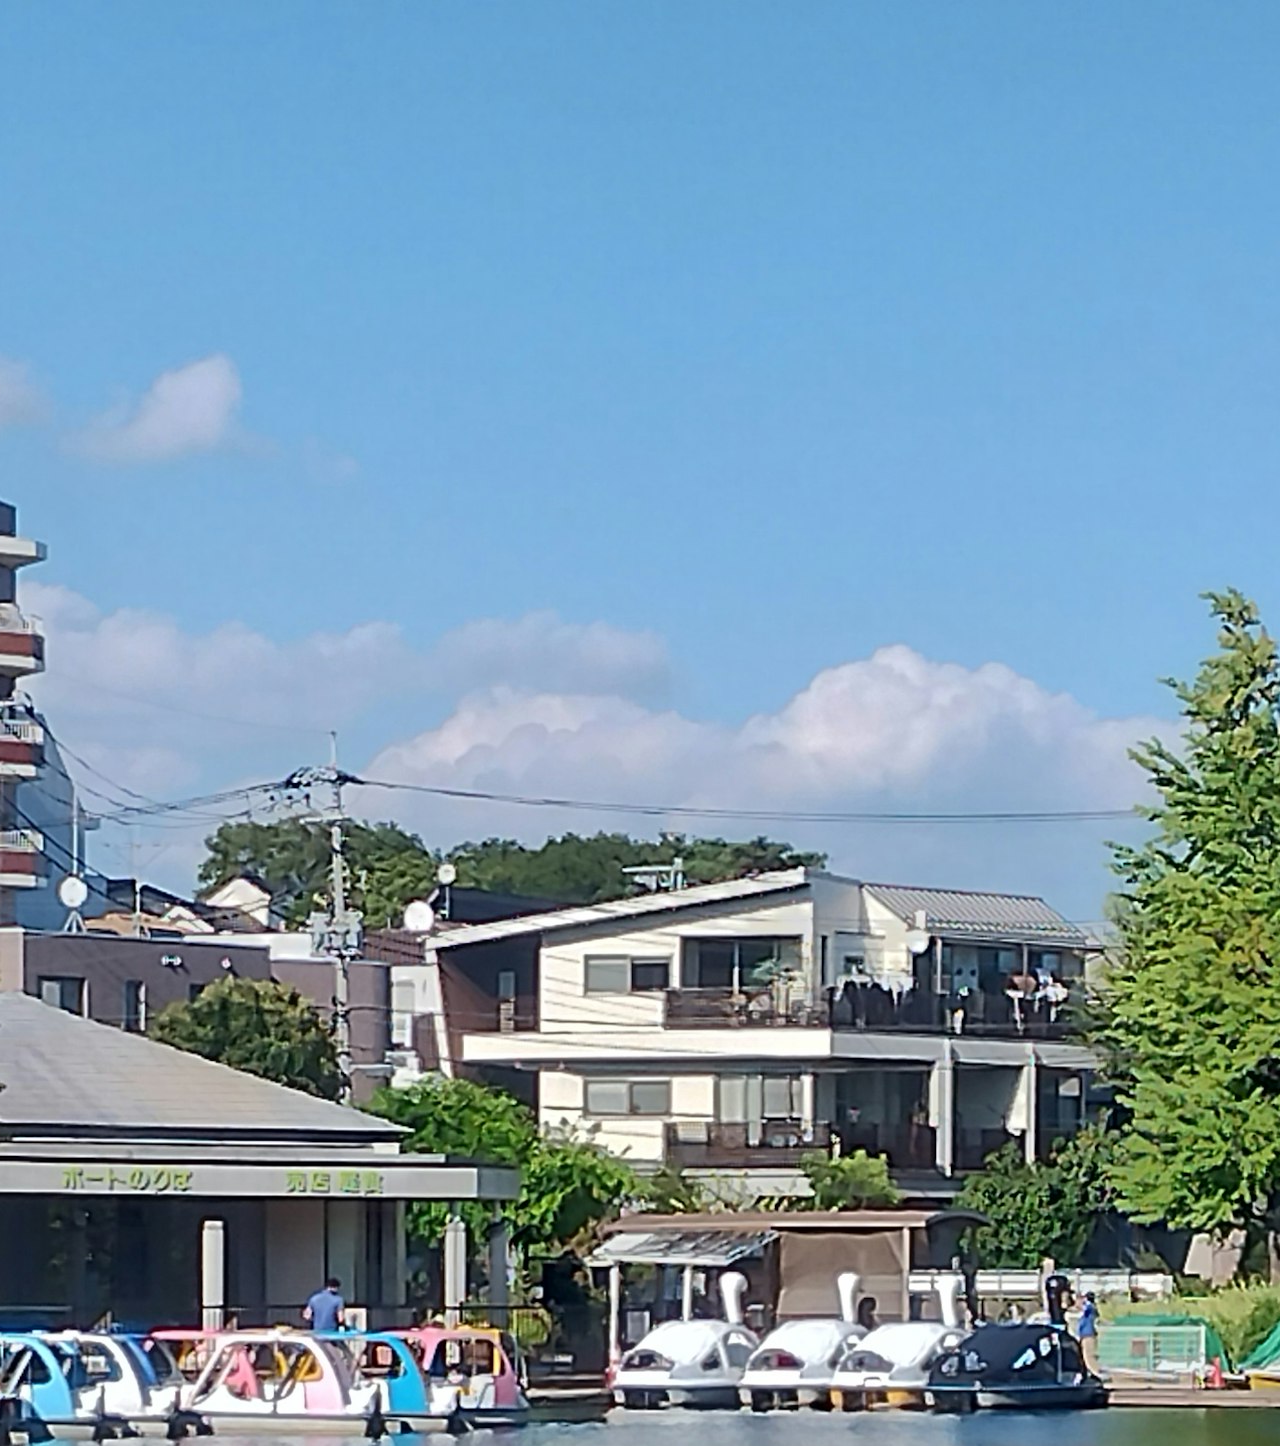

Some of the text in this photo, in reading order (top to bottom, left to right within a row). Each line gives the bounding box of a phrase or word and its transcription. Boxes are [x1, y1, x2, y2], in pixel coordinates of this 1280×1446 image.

[62, 1167, 193, 1192] ボートのりば
[285, 1170, 331, 1193] 売店
